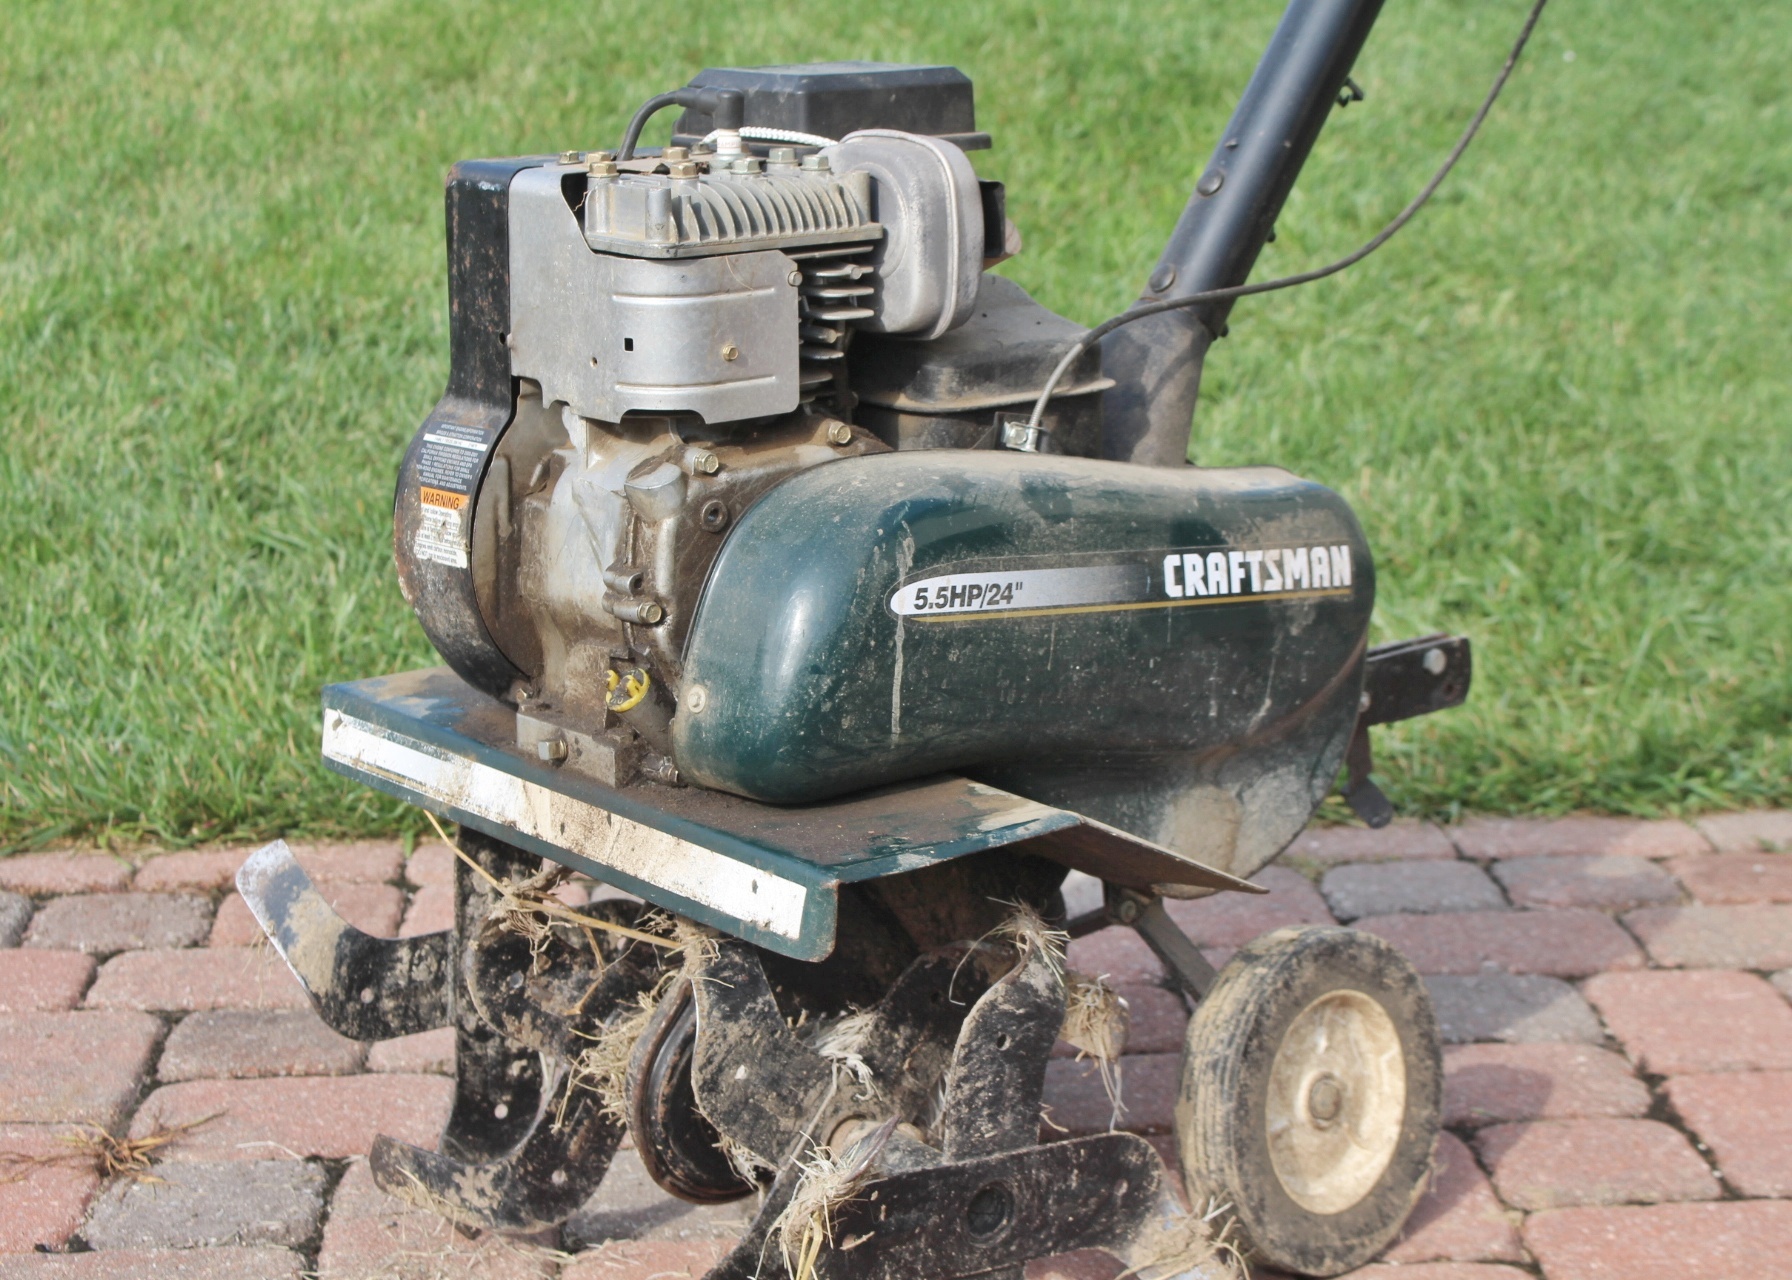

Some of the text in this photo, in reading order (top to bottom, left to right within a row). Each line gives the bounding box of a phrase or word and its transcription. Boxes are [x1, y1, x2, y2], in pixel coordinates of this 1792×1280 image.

[423, 490, 460, 510] WARNING
[1163, 544, 1352, 598] CRAFTSMAN
[913, 581, 1023, 610] 5.5HP/24"
